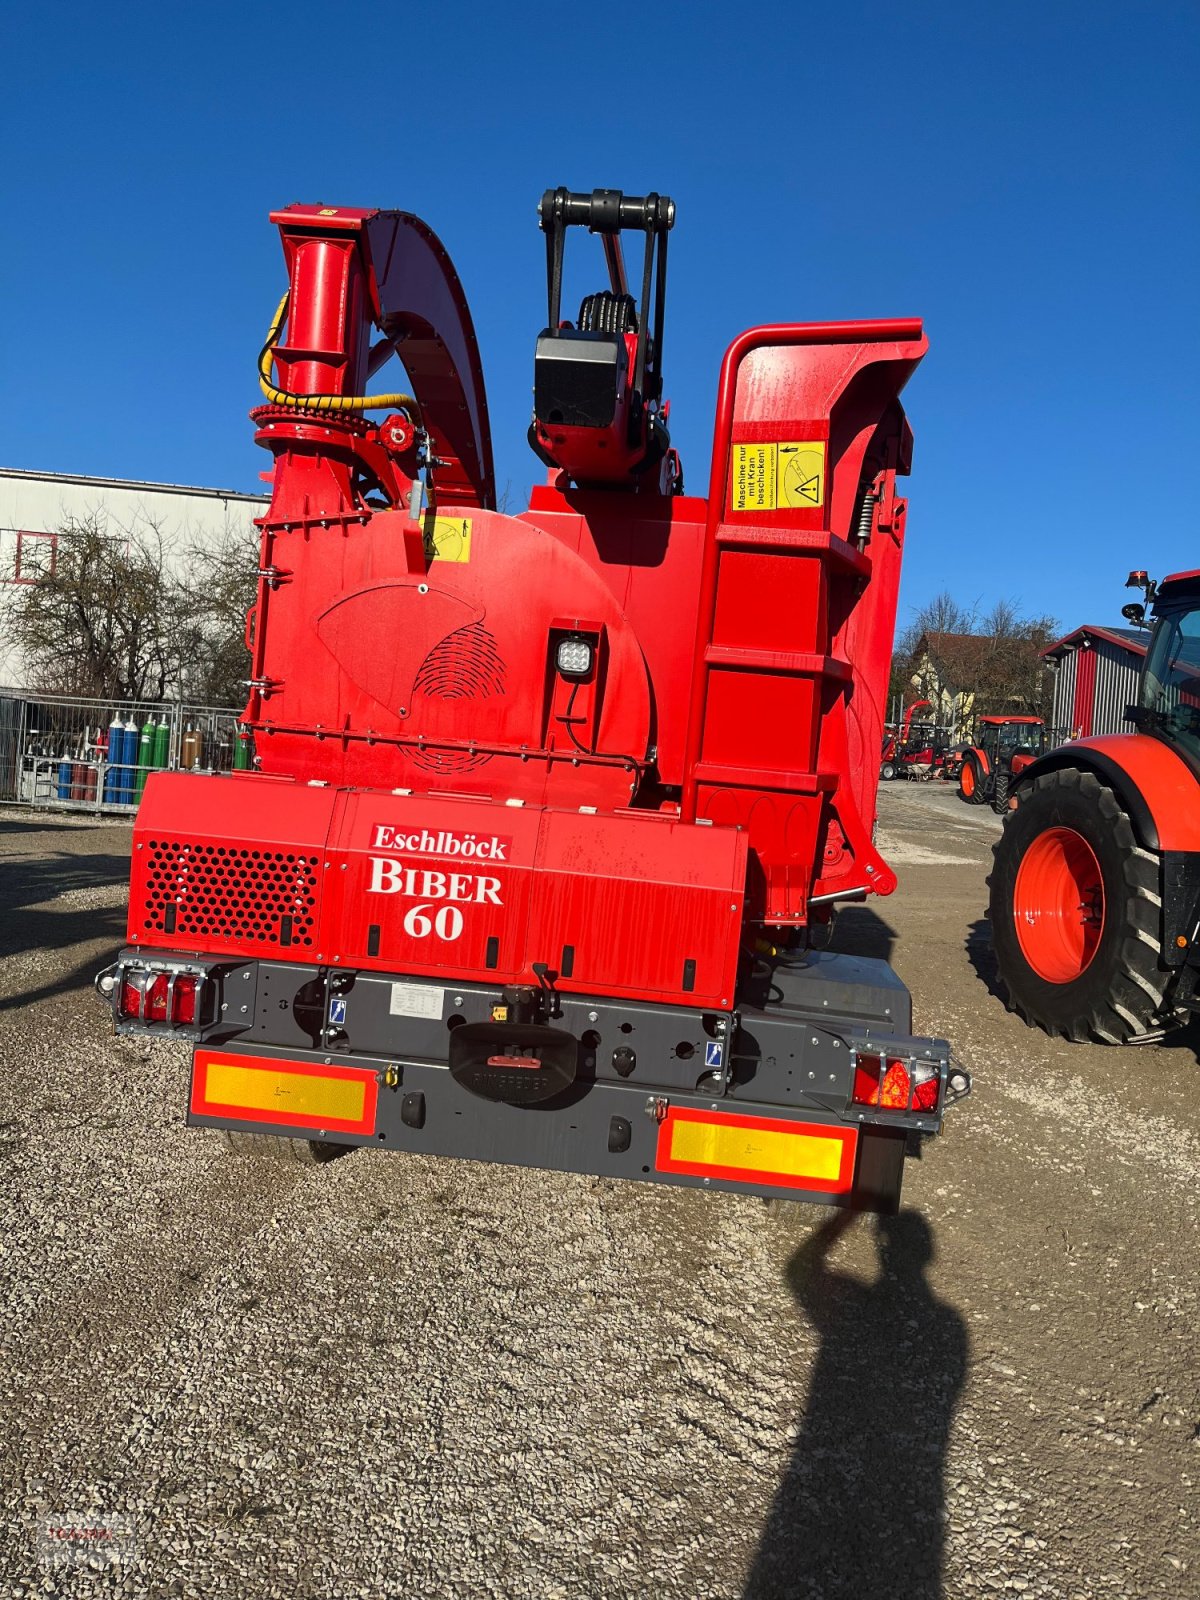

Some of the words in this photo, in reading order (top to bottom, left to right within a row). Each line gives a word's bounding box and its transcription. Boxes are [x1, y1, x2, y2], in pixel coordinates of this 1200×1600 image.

[738, 465, 746, 508] Maschine
[757, 449, 765, 504] beschicken!
[372, 825, 508, 860] Eschlböck
[366, 857, 504, 905] BIBER
[403, 904, 464, 941] 60
